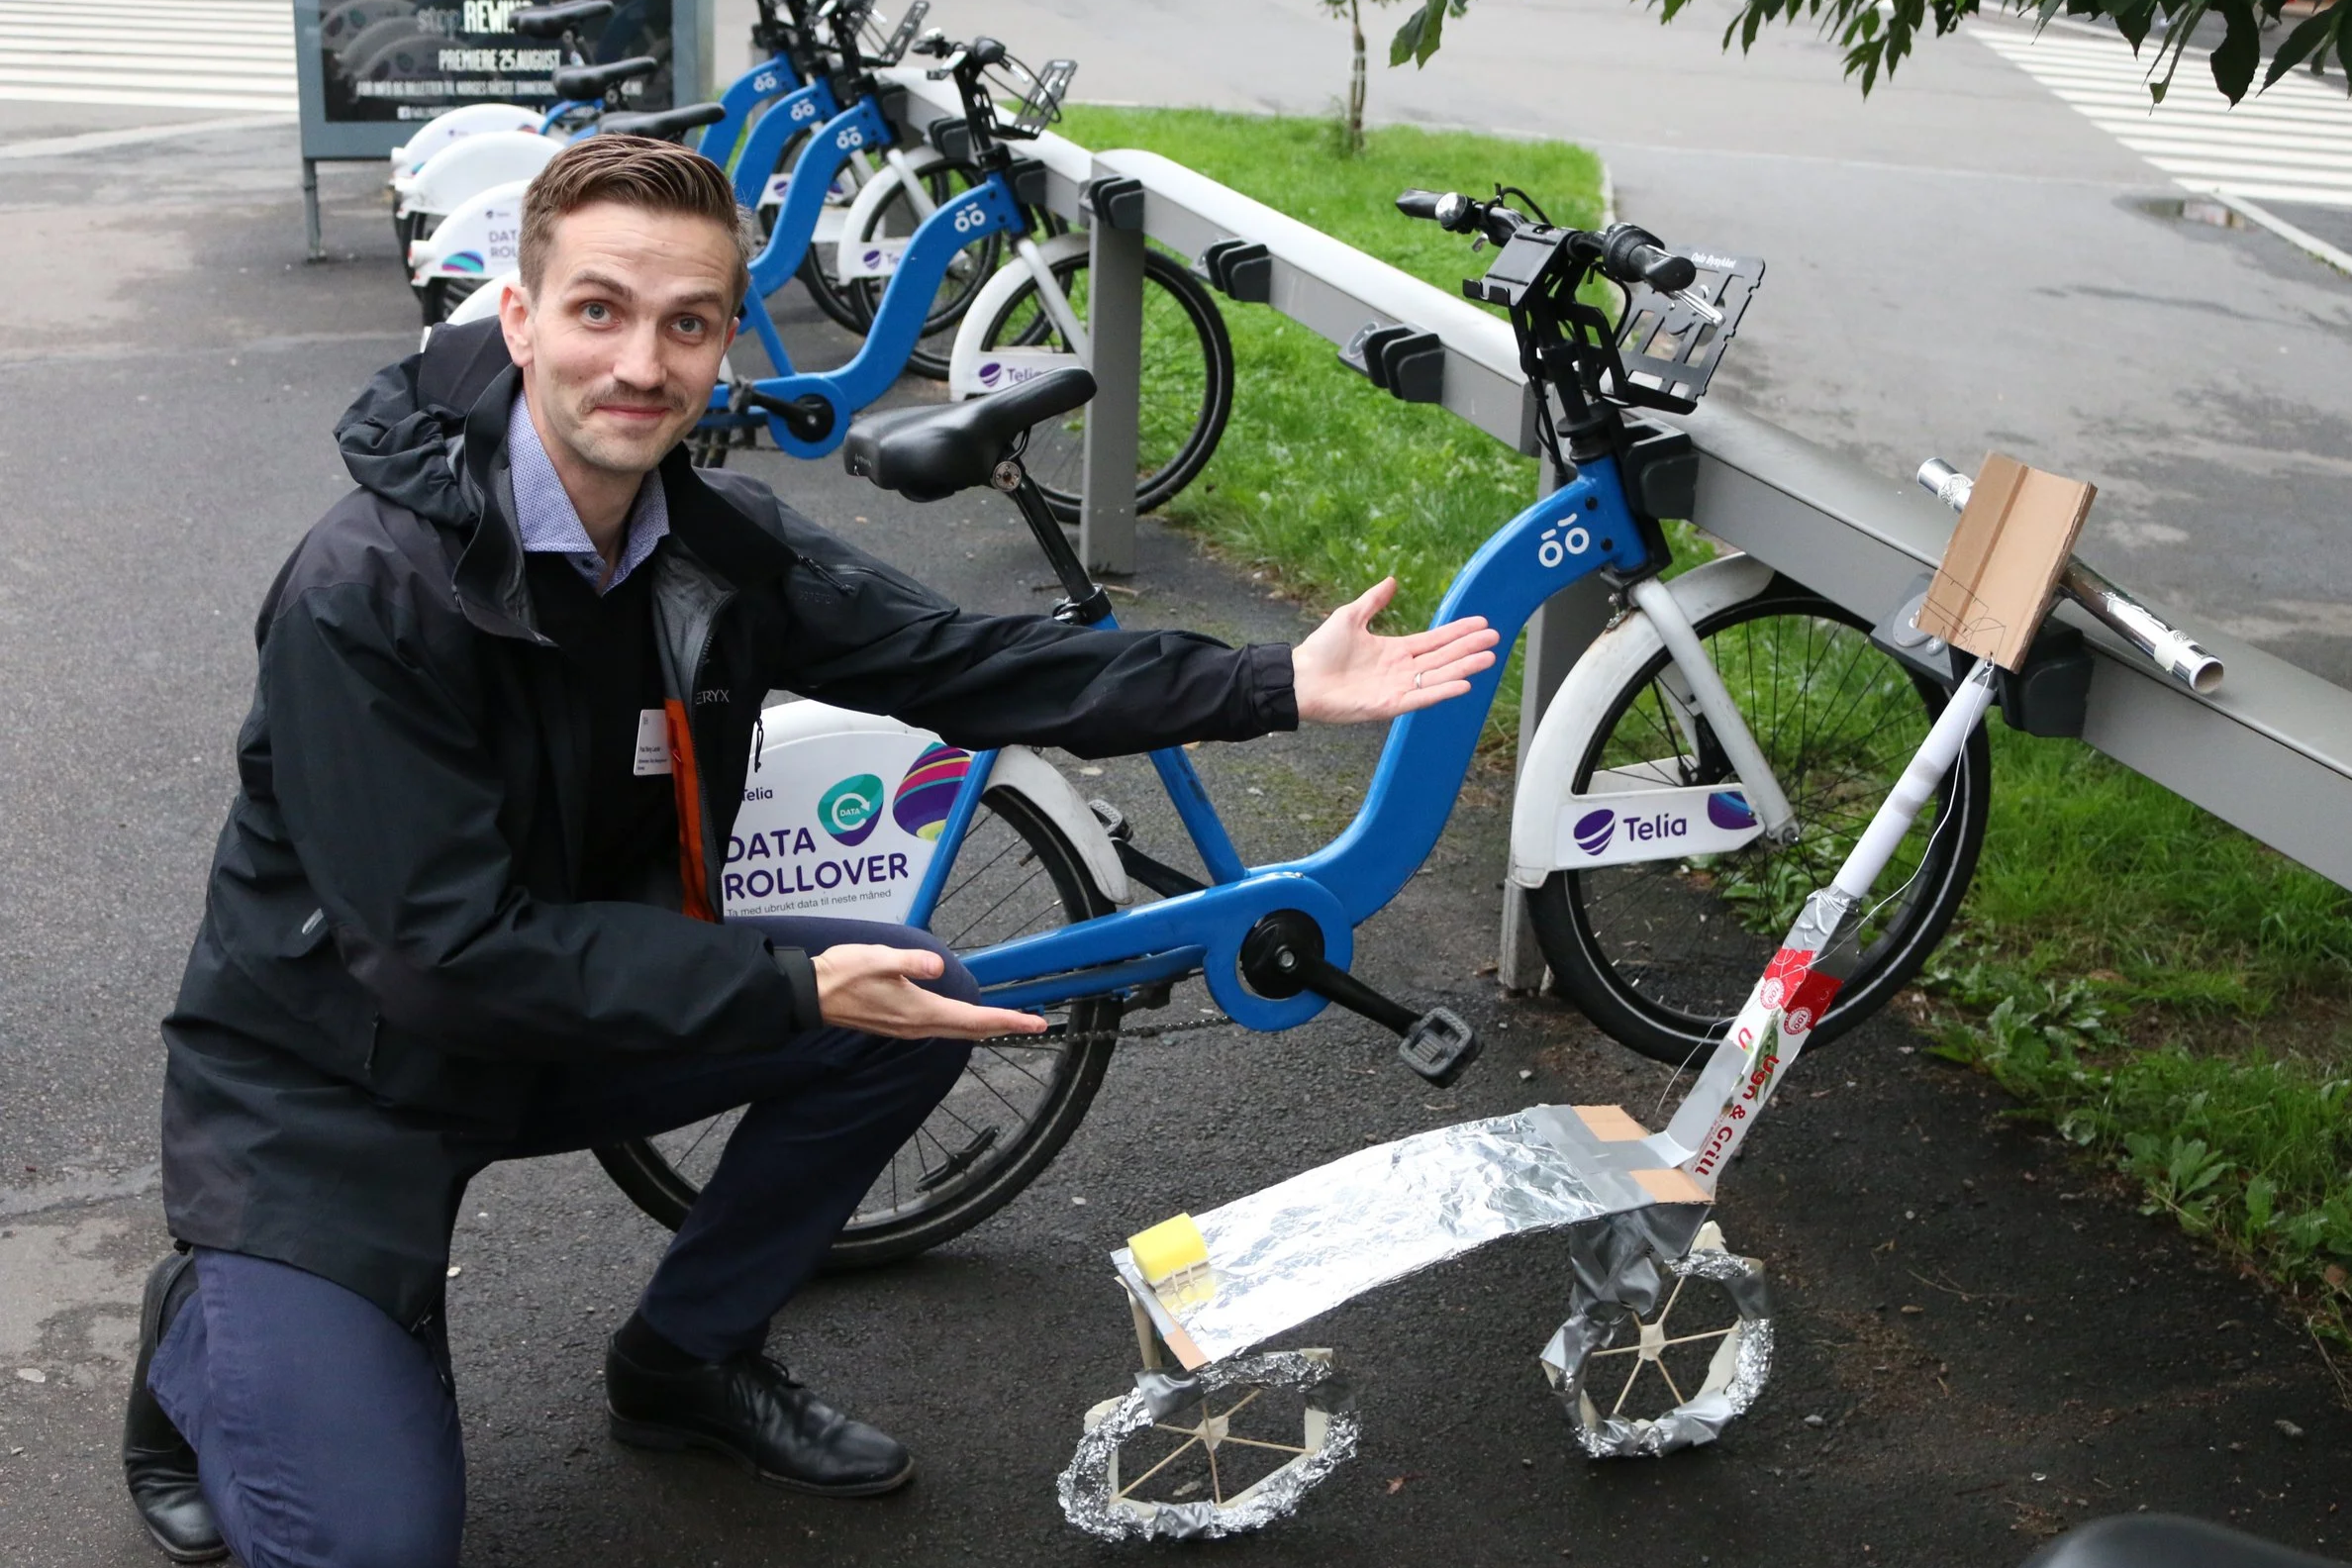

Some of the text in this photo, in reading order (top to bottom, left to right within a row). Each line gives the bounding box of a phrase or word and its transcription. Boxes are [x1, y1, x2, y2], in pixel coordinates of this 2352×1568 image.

[439, 49, 496, 70] PREMIERE
[517, 49, 560, 70] AUGUST
[839, 808, 860, 817] DATA
[1622, 813, 1687, 841] Telia
[726, 827, 816, 864] DATA
[724, 852, 909, 901] ROLLOVER
[740, 906, 762, 917] med
[764, 902, 795, 914] ubrukt
[797, 898, 819, 910] data
[820, 896, 830, 906] til
[832, 893, 857, 905] neste
[859, 889, 892, 902] måned
[1742, 1054, 1780, 1101] Ugn
[1728, 1104, 1746, 1121] &
[1695, 1126, 1733, 1176] Grill
